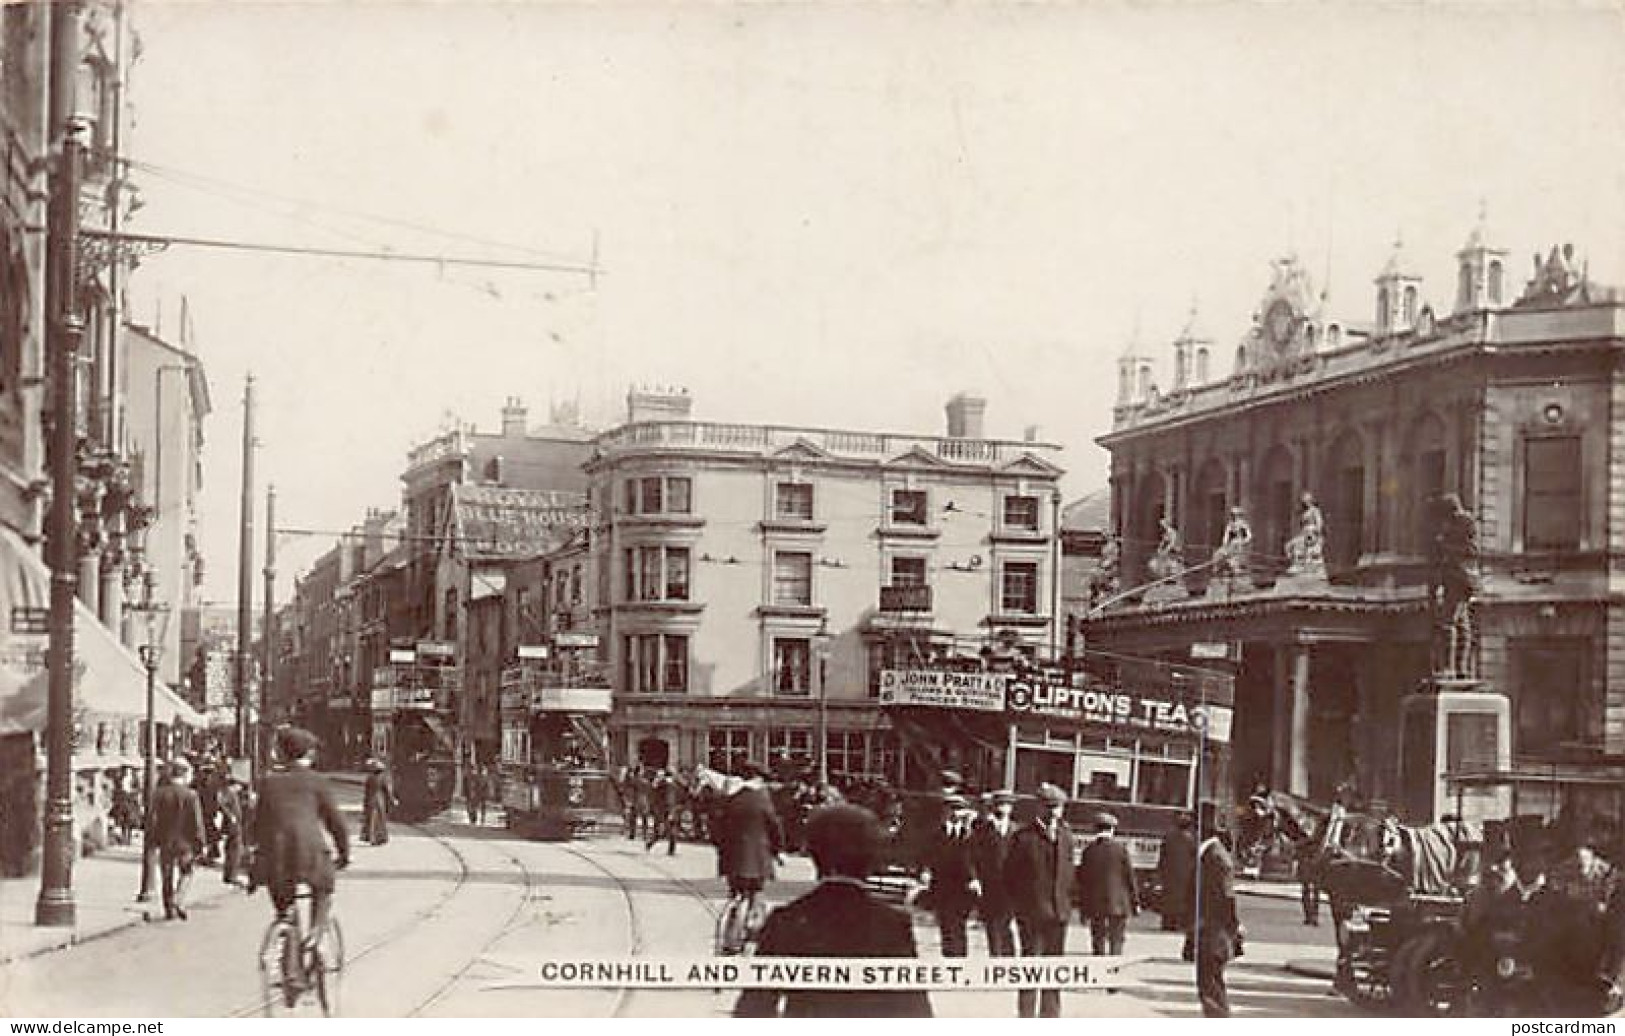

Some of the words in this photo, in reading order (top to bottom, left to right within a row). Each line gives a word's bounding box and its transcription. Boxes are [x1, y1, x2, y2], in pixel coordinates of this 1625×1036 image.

[901, 673, 937, 686] JOHN
[944, 674, 981, 689] PRATT
[1140, 700, 1187, 723] TEA
